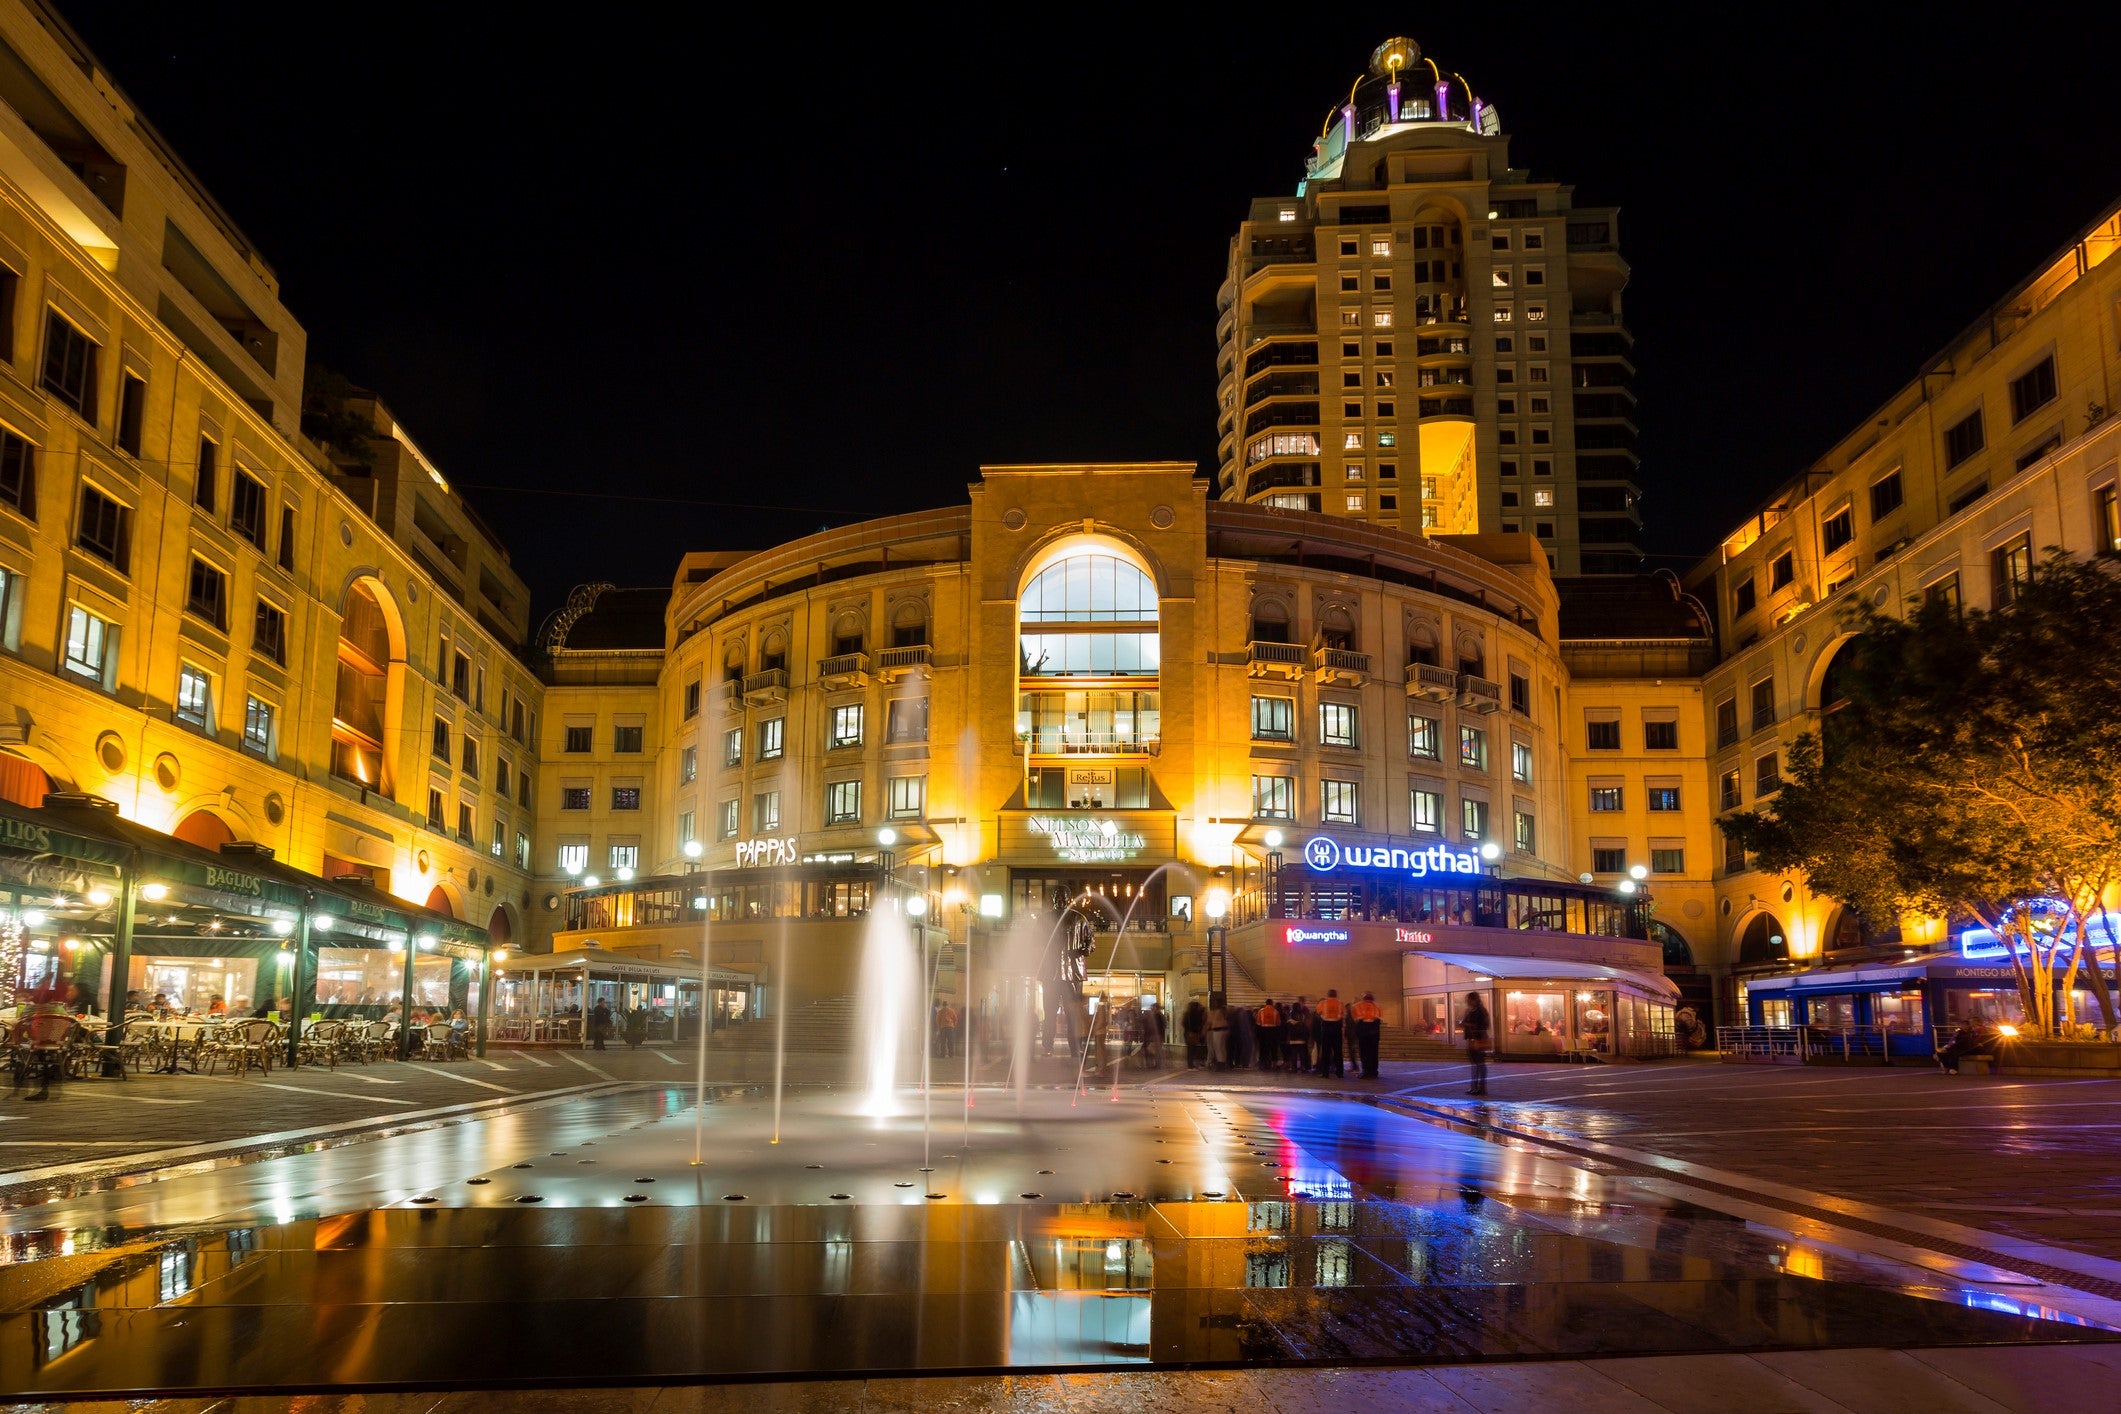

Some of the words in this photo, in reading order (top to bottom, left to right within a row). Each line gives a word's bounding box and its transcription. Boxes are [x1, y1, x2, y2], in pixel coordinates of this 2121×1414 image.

[1076, 774, 1106, 783] Regus
[1030, 816, 1103, 834] NELSON
[1053, 831, 1144, 848] MANDELA
[735, 838, 796, 868] PAPPAS
[1069, 849, 1126, 862] SQUARE
[1345, 844, 1480, 878] wangthai
[206, 866, 261, 895] BAGLIOS
[1303, 929, 1348, 942] wangthai
[1955, 968, 1999, 977] MONTEGO
[2000, 968, 2016, 977] BAY
